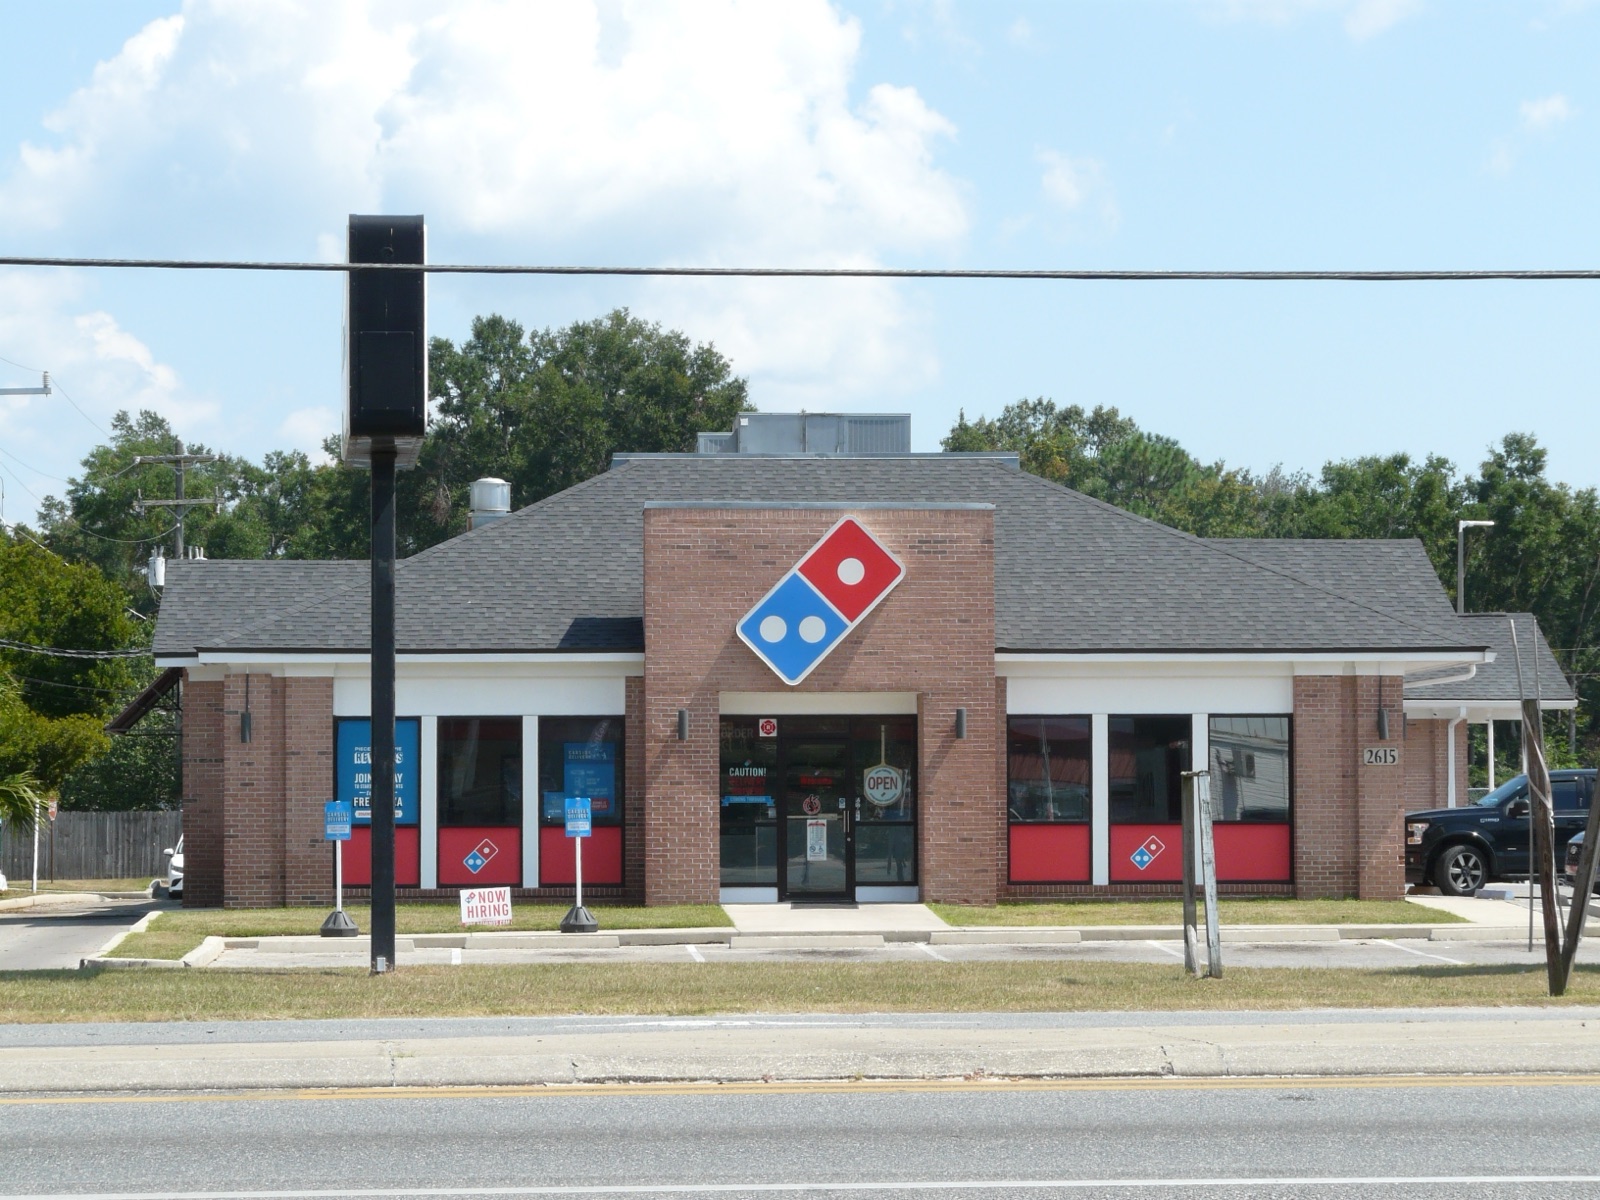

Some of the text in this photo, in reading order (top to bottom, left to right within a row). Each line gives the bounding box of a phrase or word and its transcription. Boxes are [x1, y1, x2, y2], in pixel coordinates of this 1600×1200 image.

[1366, 749, 1396, 764] 2615
[729, 768, 767, 777] CAUTION!
[868, 777, 898, 790] OPEN
[478, 890, 506, 904] NOW
[467, 904, 509, 918] HIRING
